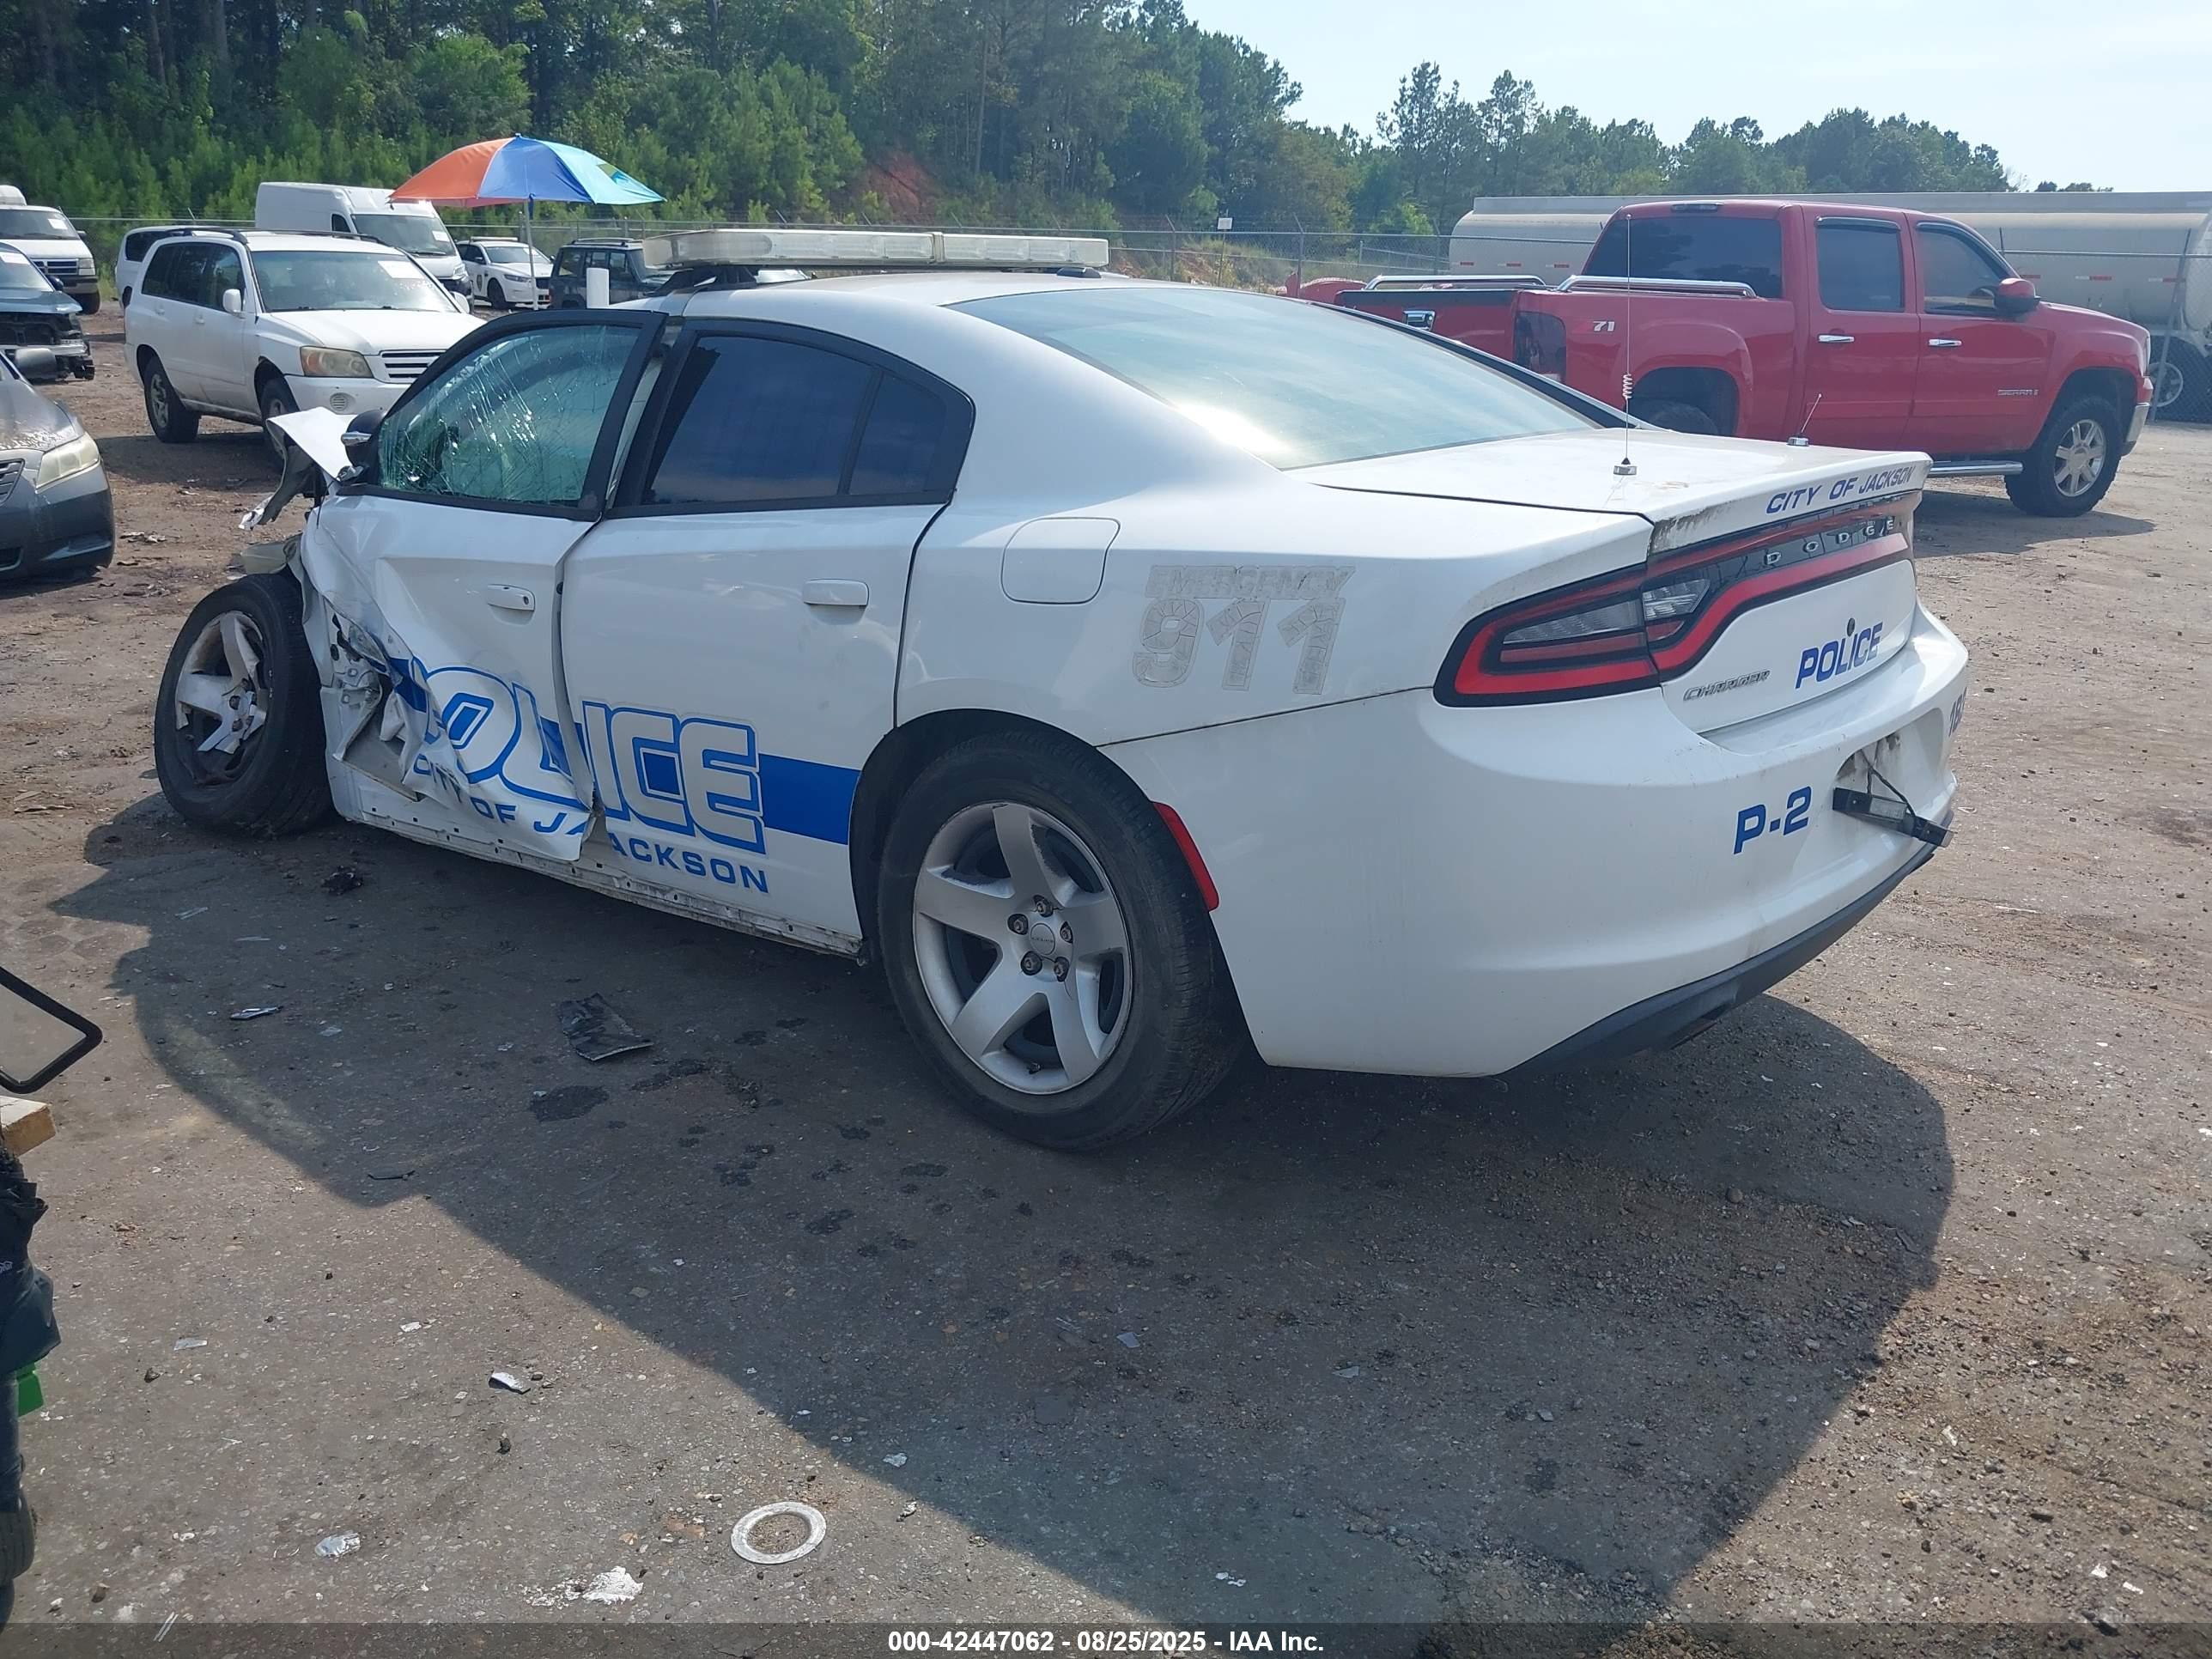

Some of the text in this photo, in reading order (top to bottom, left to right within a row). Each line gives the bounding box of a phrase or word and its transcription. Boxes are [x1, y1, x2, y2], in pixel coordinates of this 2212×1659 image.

[1765, 465, 1916, 514] CITY OF JACKSON
[1765, 519, 1895, 566] DODGE
[1133, 599, 1346, 695] 911
[1794, 621, 1883, 690] POLICE
[1682, 669, 1771, 702] CHARGER
[470, 795, 517, 824] OF
[1733, 785, 1812, 855] P-2
